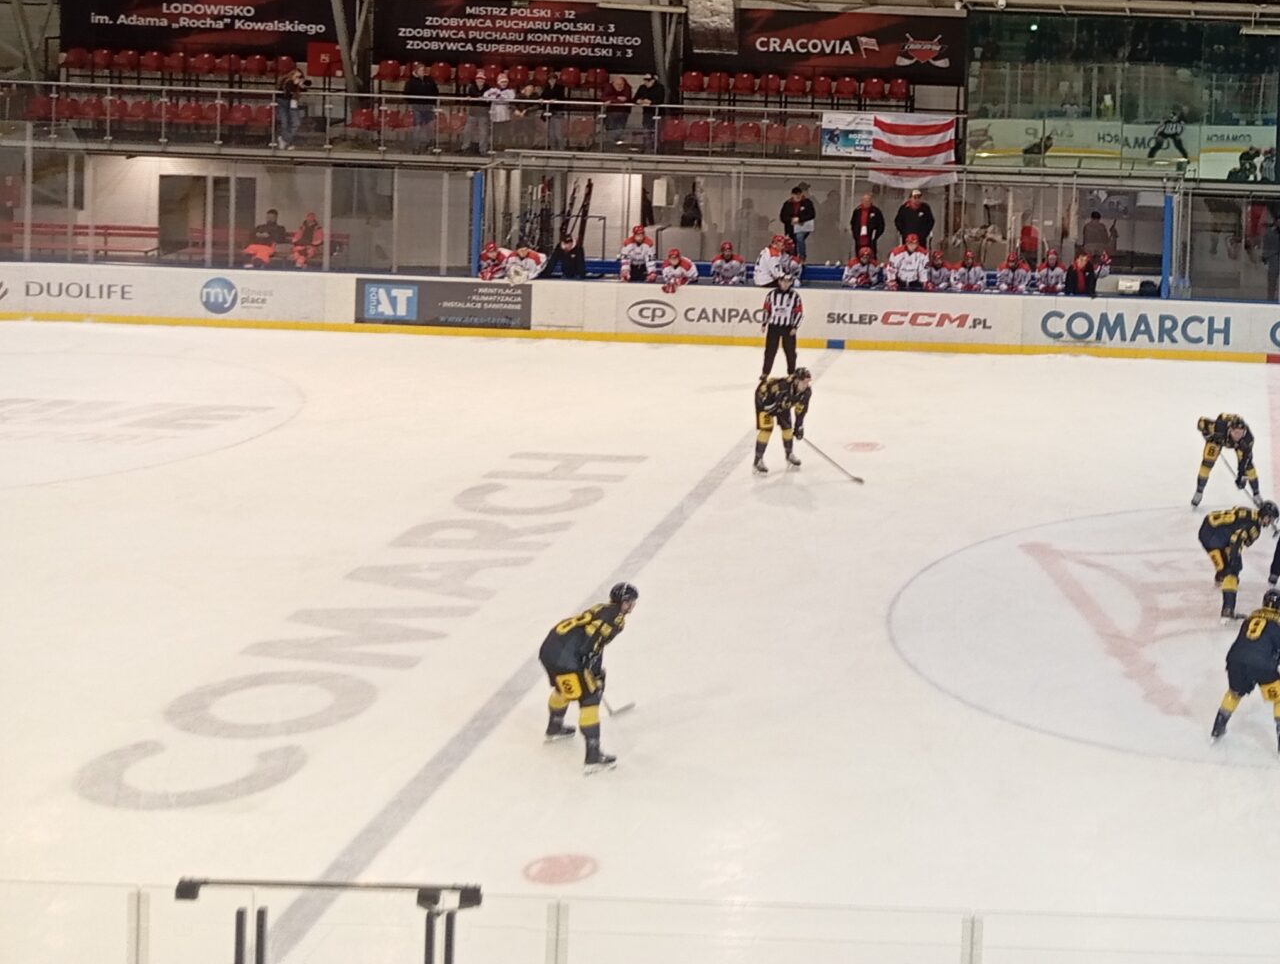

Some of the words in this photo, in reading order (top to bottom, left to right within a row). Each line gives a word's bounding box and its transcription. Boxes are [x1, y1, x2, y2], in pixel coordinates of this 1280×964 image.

[162, 2, 256, 17] LODOWISKO
[466, 6, 508, 17] MISTRZ
[510, 8, 551, 18] POLSKI
[564, 10, 576, 19] 12
[91, 12, 114, 25] im.
[117, 14, 168, 27] Adama
[234, 19, 326, 35] Kowalskiego
[425, 17, 493, 28] ZDOBYWCA
[496, 20, 551, 30] PUCHARU
[554, 22, 595, 32] POLSKI
[607, 24, 616, 32] 3
[398, 28, 466, 39] ZDOBYWCA
[468, 31, 524, 41] PUCHARU
[527, 33, 642, 46] KONTYNENTALNEGO
[755, 37, 854, 54] CRACOVIA
[406, 40, 474, 52] ZDOBYWCA
[476, 43, 569, 55] SUPERPUCHARU
[572, 47, 613, 57] POLSKI
[626, 49, 633, 57] 3
[25, 281, 133, 300] DUOLIFE
[202, 288, 236, 307] my
[378, 288, 413, 316] AT
[684, 306, 766, 324] CANPAC
[827, 312, 878, 325] SKLEP
[1041, 309, 1231, 344] COMARCH
[72, 451, 649, 811] COMARCH
